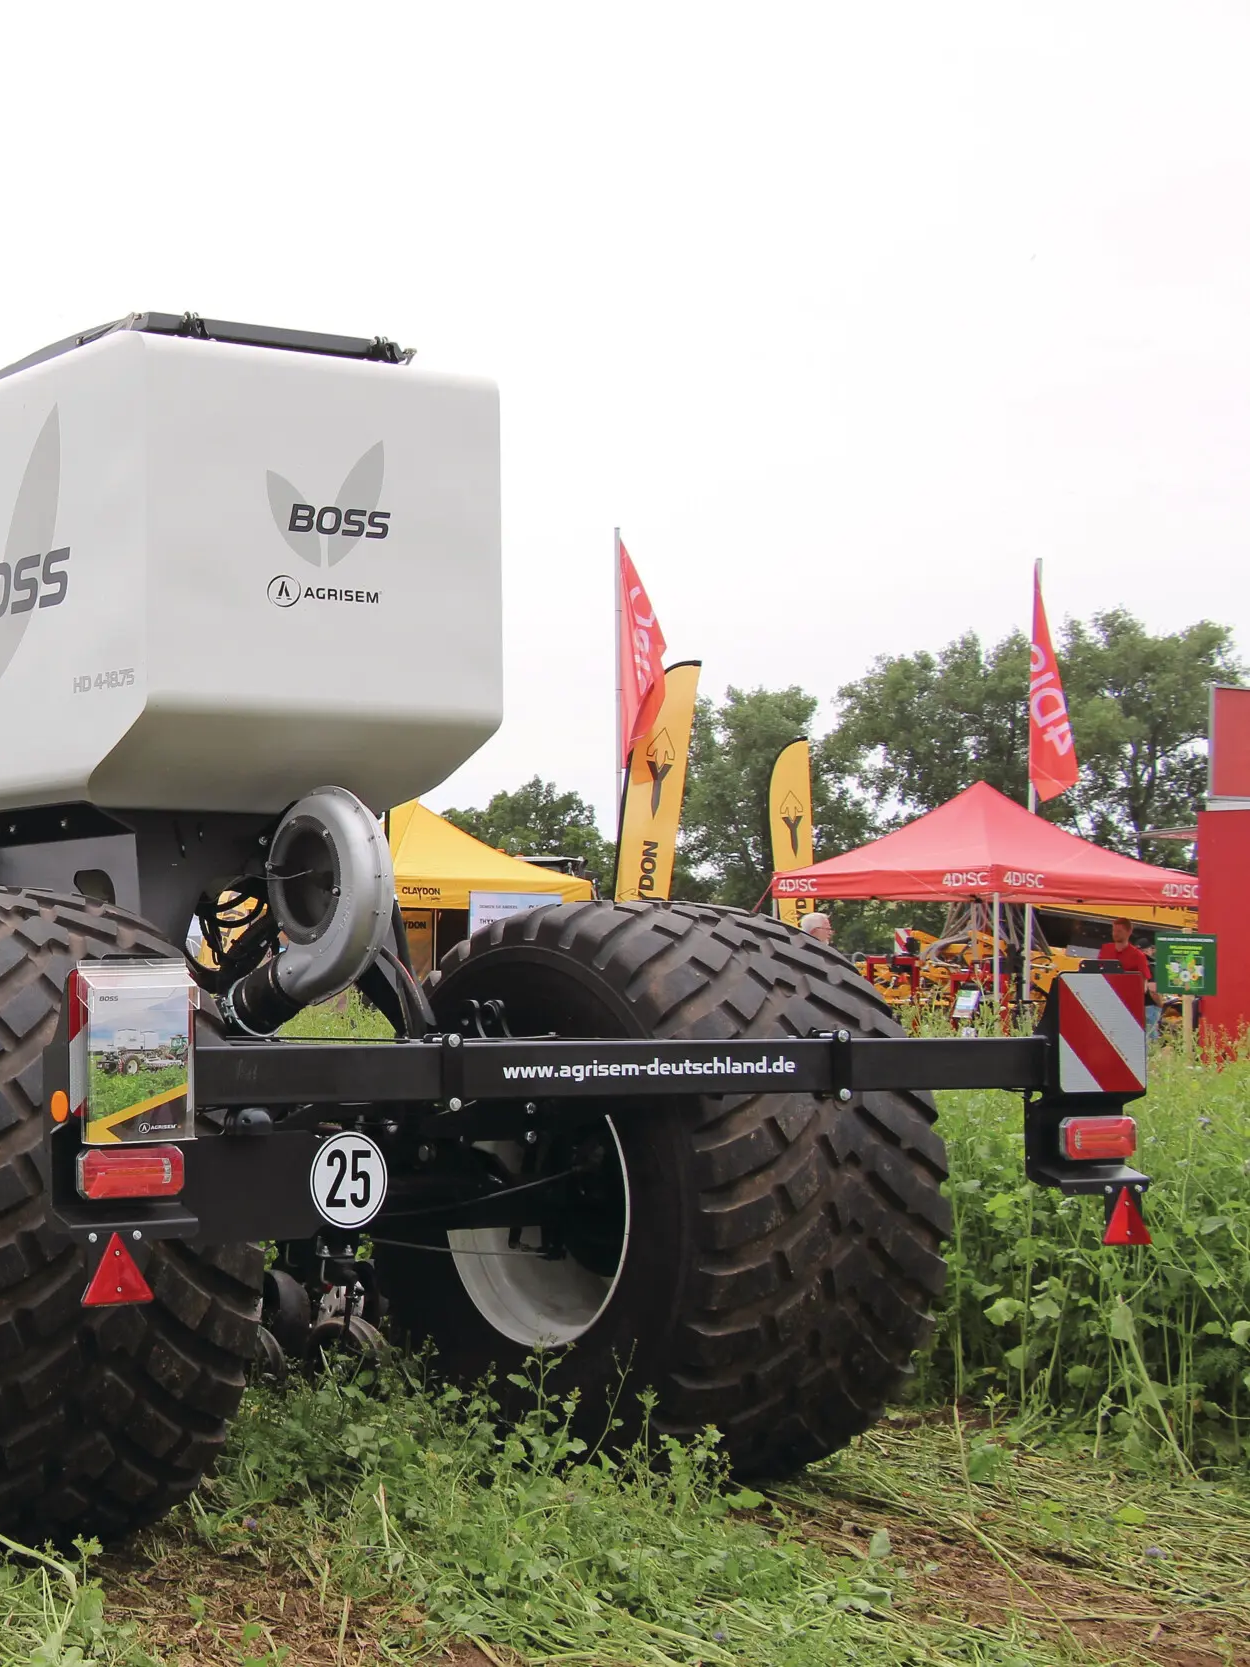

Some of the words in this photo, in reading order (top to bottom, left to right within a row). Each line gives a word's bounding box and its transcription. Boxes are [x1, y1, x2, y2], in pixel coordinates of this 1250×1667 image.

[288, 503, 391, 539] BOSS
[304, 587, 380, 603] AGRISEM
[73, 676, 92, 693] HD
[778, 878, 818, 892] 4DISC
[942, 872, 989, 887] 4DISC
[1002, 871, 1045, 888] 4DISC
[402, 887, 441, 900] CLAYDON
[502, 1056, 796, 1082] www.agrisem-deutschland.de
[325, 1149, 371, 1208] 25
